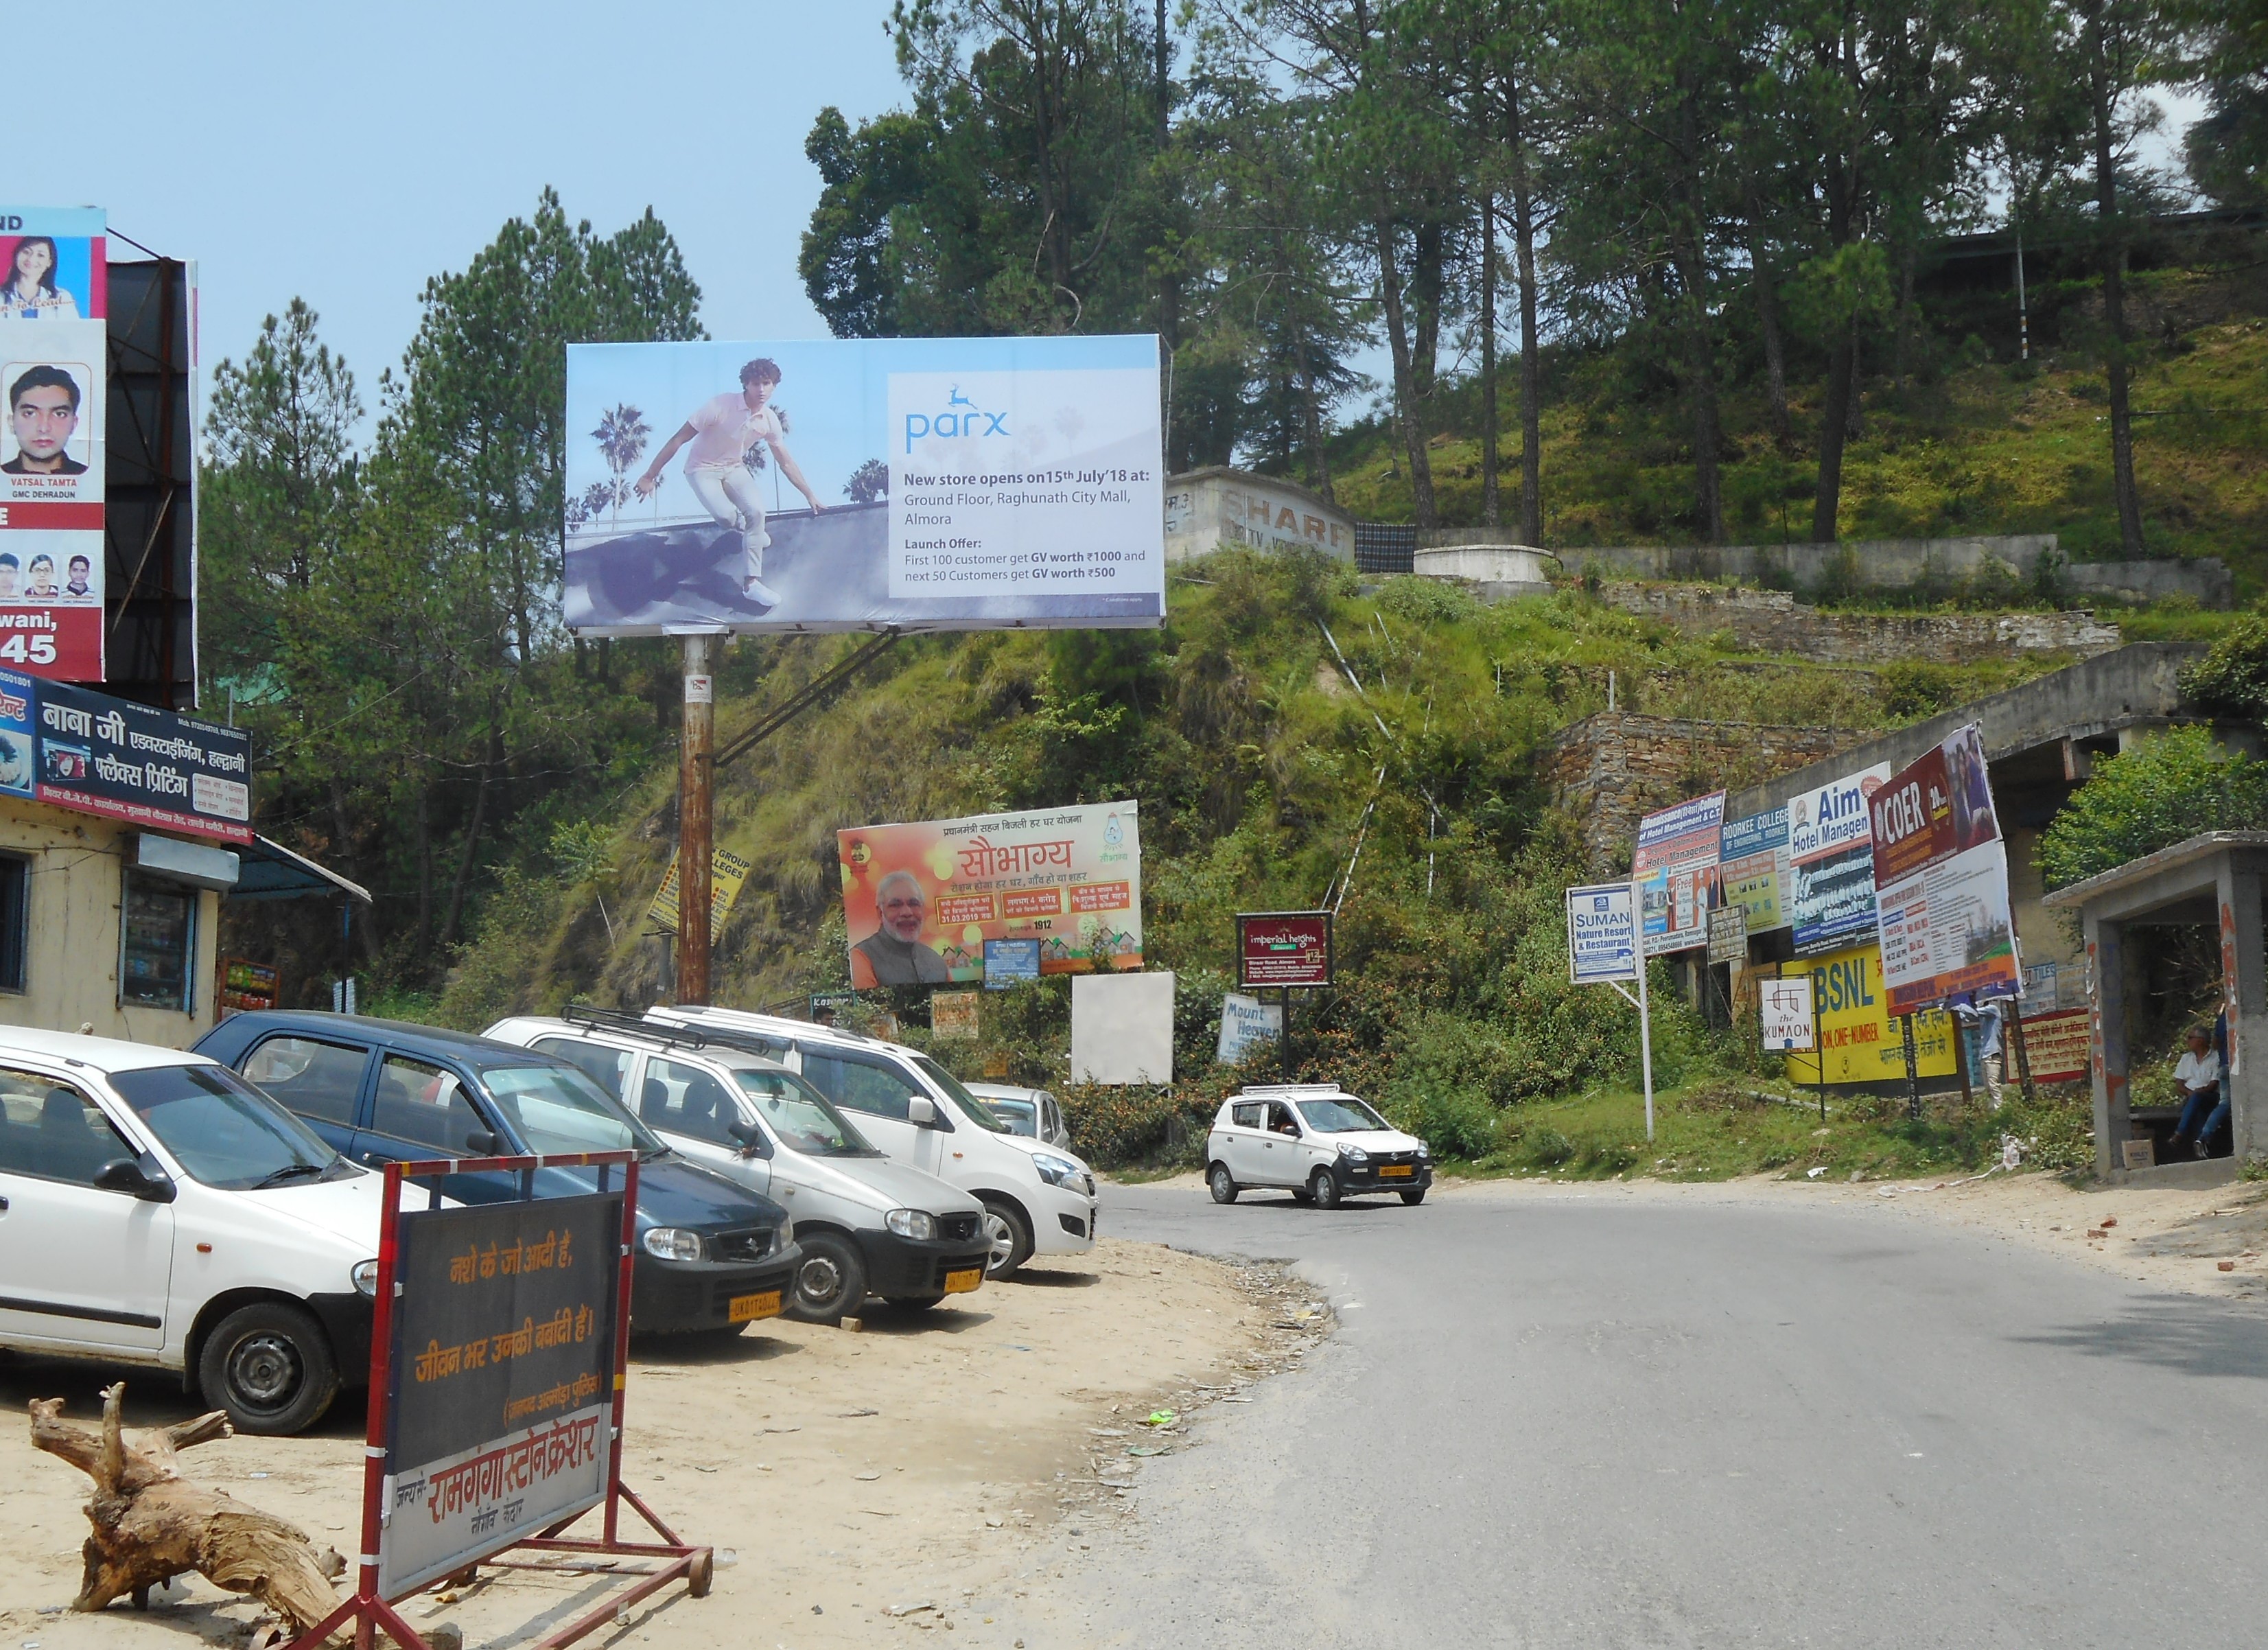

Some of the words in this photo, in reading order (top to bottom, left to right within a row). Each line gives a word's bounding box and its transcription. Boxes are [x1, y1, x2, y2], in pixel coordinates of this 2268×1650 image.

[907, 412, 1011, 454] parx
[11, 478, 44, 487] VATSAL
[47, 478, 77, 487] TAMTA
[904, 474, 935, 485] New
[939, 474, 976, 485] store
[981, 475, 1023, 487] opens
[1131, 471, 1149, 482] at:
[905, 493, 953, 506] Ground
[958, 493, 993, 507] Floor,
[997, 491, 1068, 507] Raghunath
[1072, 490, 1097, 505] City
[1101, 490, 1131, 503] Mall,
[904, 513, 952, 525] Almora
[905, 539, 946, 549] Launch
[949, 539, 981, 549] Offer:
[905, 555, 928, 566] First
[933, 555, 952, 565] 100
[955, 555, 1007, 565] customer
[1010, 555, 1029, 566] get
[1031, 553, 1047, 563] GV
[1050, 552, 1084, 563] worth
[1087, 551, 1121, 562] ₹1000
[1124, 550, 1145, 561] and
[905, 572, 930, 581] next
[933, 571, 946, 581] 50
[949, 570, 1007, 581] Customers
[1011, 571, 1029, 582] get
[1032, 569, 1048, 579] GV
[1051, 568, 1085, 579] worth
[1088, 568, 1115, 578] ₹500
[1, 634, 56, 664] 45
[42, 701, 92, 738] बाबा
[95, 710, 126, 745] जी
[1818, 787, 1860, 826] Aim
[1884, 782, 1926, 844] COER
[944, 822, 977, 836] प्रधानमंत्री
[980, 824, 1000, 833] सहज
[1002, 818, 1027, 830] बिजली
[1030, 820, 1040, 828] हर
[1044, 818, 1055, 826] घर
[1056, 814, 1082, 825] योजना
[1639, 833, 1646, 841] of
[1647, 828, 1663, 839] Hotel
[1664, 815, 1702, 833] Management
[1703, 812, 1708, 821] &
[1723, 819, 1754, 840] ROORKEE
[1757, 808, 1789, 830] COLLEGE
[1726, 840, 1733, 850] OF
[1765, 826, 1786, 839] ROORKEE
[1793, 827, 1819, 854] Hotel
[718, 849, 750, 868] GROUP
[957, 835, 1075, 877] सौभाग्य
[1646, 857, 1667, 868] Hotel
[1670, 841, 1718, 861] Management
[996, 878, 1006, 887] हर
[1046, 873, 1055, 883] हो
[1057, 874, 1066, 882] या
[1069, 872, 1088, 881] शहर
[1677, 877, 1692, 890] Free
[942, 914, 979, 923] 31.03.2019
[1034, 920, 1052, 930] 1912
[1576, 911, 1630, 927] SUMAN
[1250, 933, 1287, 946] imperial
[1289, 933, 1316, 949] heights
[1576, 929, 1603, 940] Nature
[1604, 927, 1631, 937] Resort
[1579, 942, 1585, 951] &
[1586, 938, 1630, 950] Restaurant
[1814, 957, 1874, 1014] BSNL
[1227, 1003, 1265, 1021] Mount
[1779, 1014, 1794, 1023] the
[1764, 1024, 1810, 1038] KUMAON
[449, 1243, 478, 1285] नशे
[480, 1240, 497, 1279] के
[500, 1236, 522, 1275] जो
[524, 1229, 557, 1273] आदी
[414, 1339, 462, 1382] जीवन
[464, 1338, 488, 1369] भर
[491, 1316, 533, 1363] उनकी
[535, 1306, 572, 1349] बर्बादी
[428, 1445, 507, 1524] रामगंगा
[505, 1427, 549, 1493] स्टोन
[547, 1415, 598, 1477] क्रेशर
